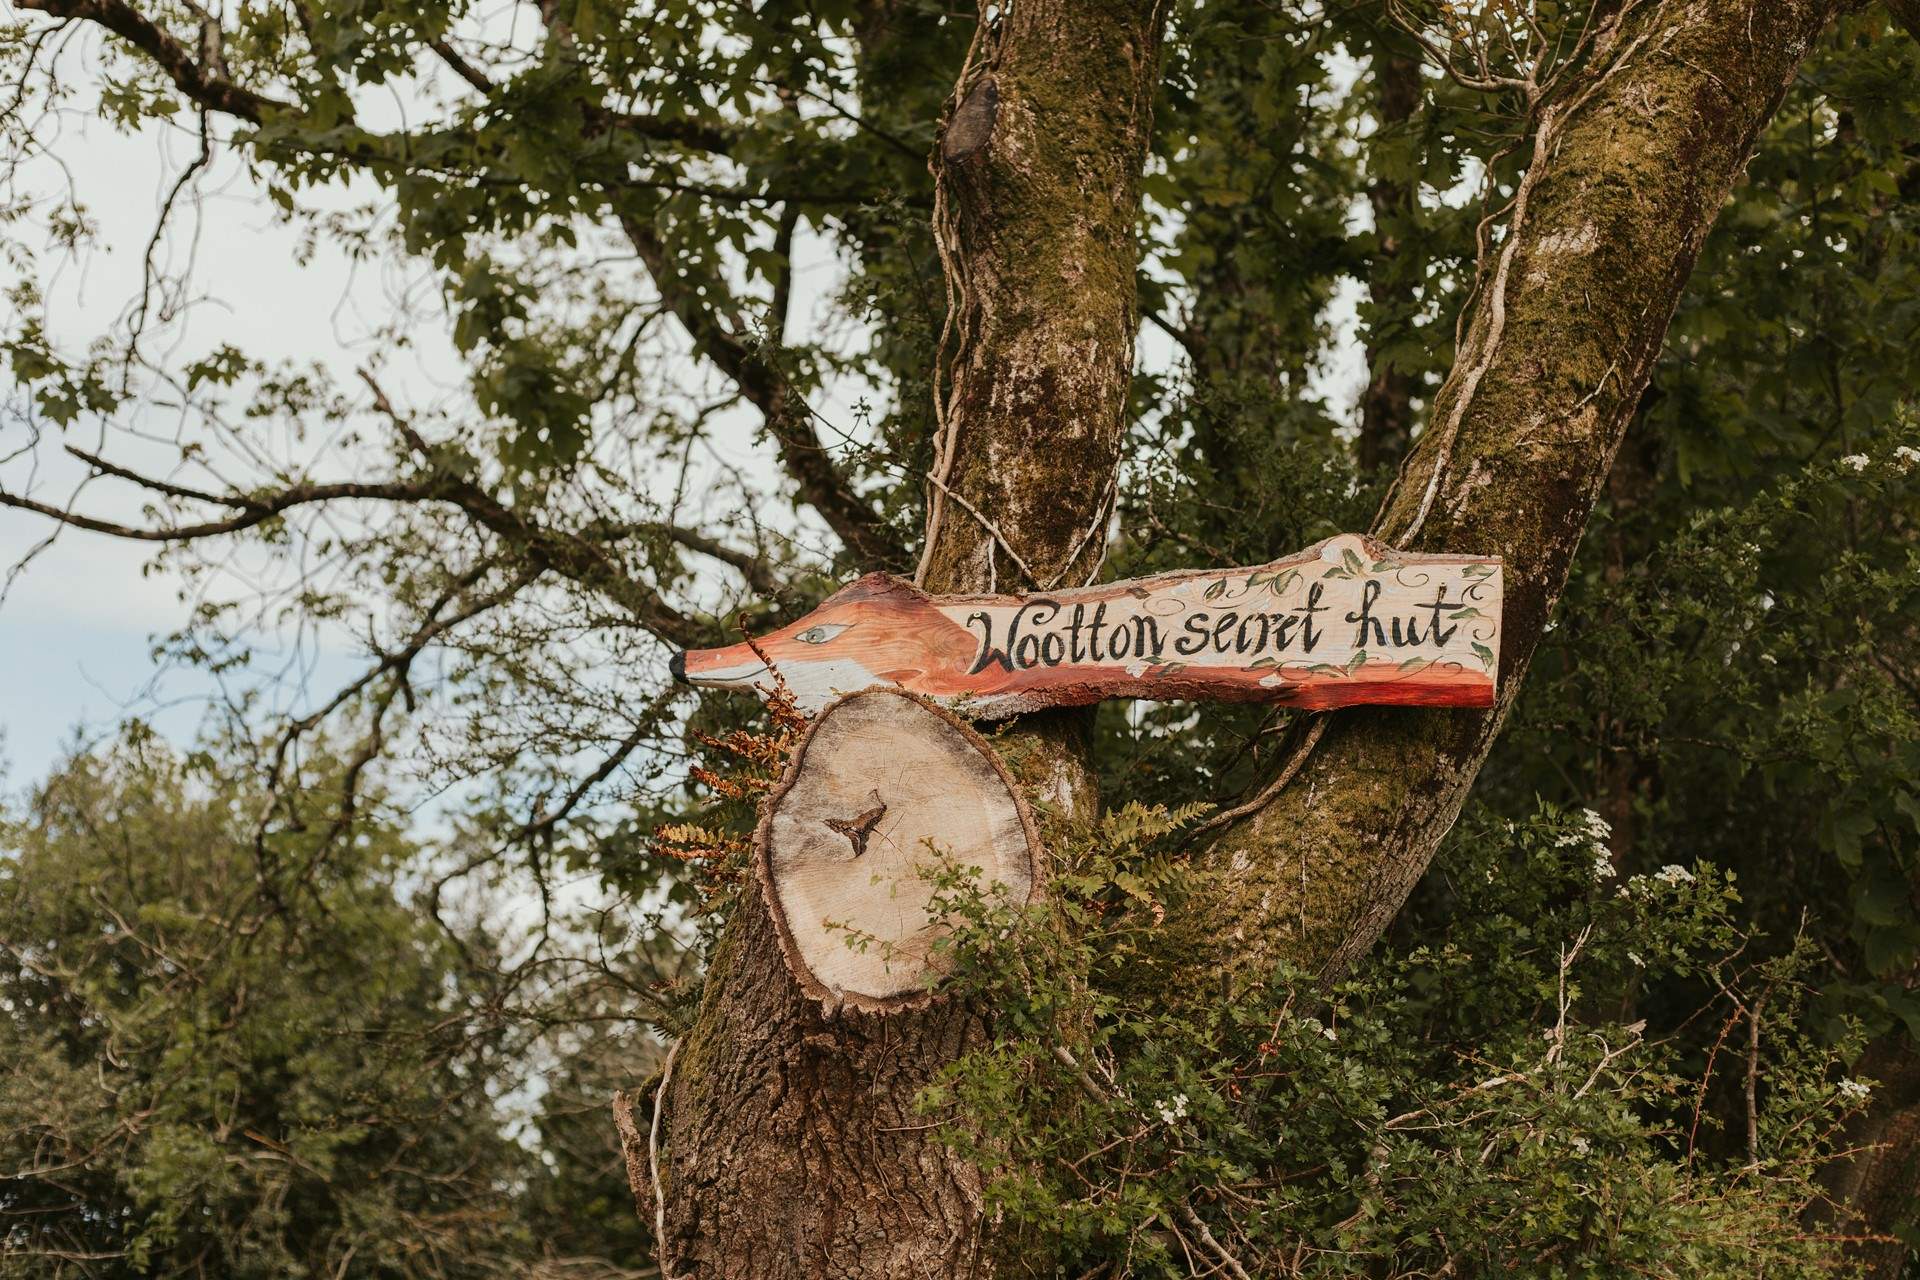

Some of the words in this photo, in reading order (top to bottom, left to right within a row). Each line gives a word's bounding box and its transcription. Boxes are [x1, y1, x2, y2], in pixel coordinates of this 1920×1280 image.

[966, 599, 1169, 674] Wootton
[1174, 581, 1330, 656] secret
[1345, 579, 1464, 648] hut
